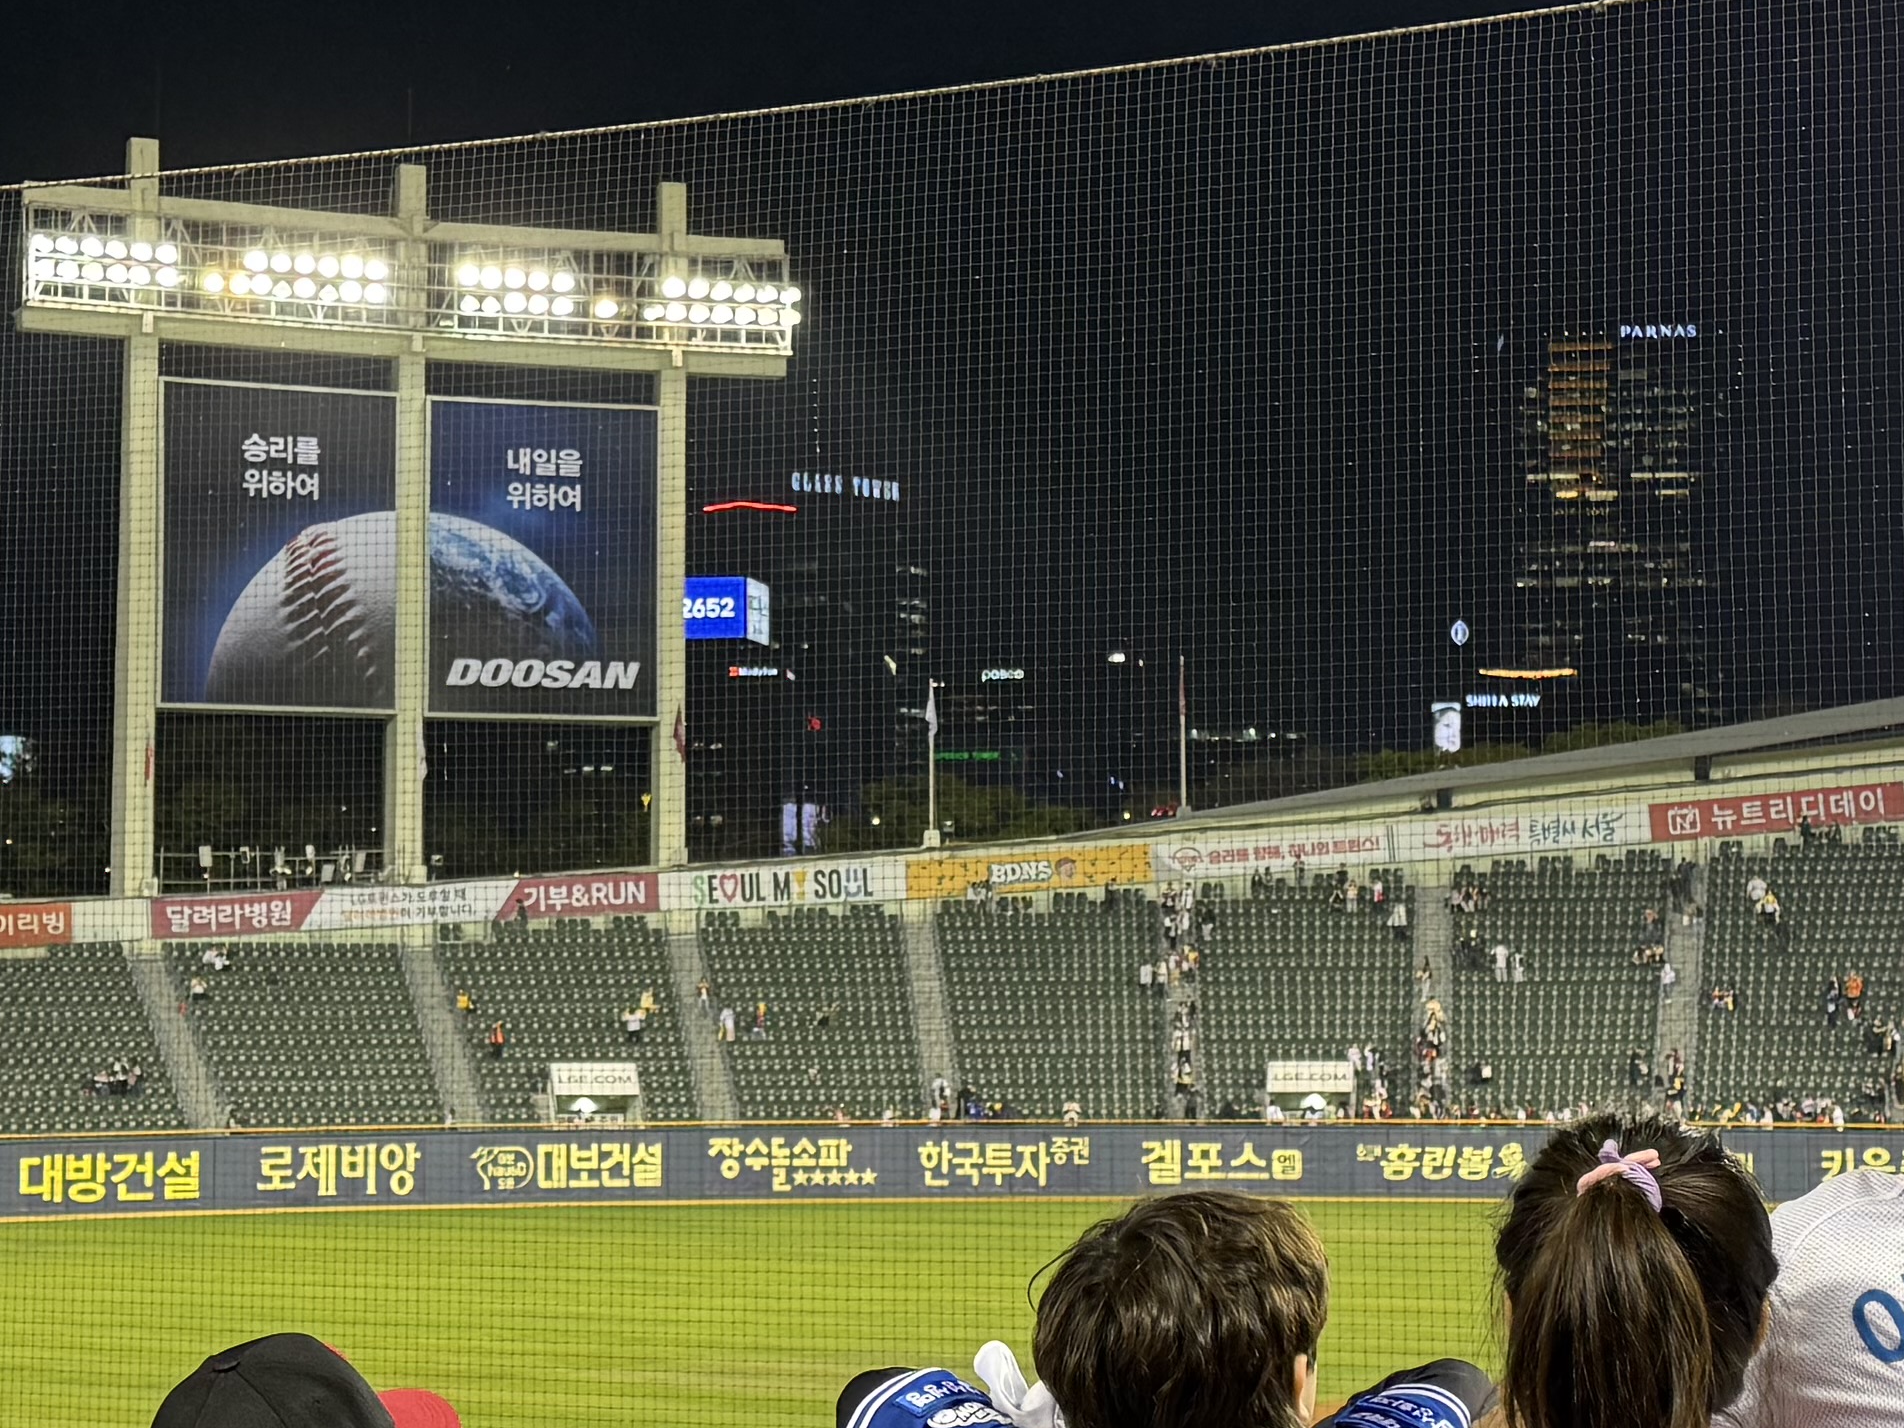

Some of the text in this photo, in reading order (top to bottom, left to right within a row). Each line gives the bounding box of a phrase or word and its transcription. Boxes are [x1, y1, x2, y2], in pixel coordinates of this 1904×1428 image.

[1620, 324, 1697, 338] PARNAS
[241, 433, 322, 466] 승리를
[506, 448, 583, 477] 내일을
[242, 470, 320, 501] 위하여
[506, 482, 582, 512] 위하여
[446, 658, 640, 689] DOOSAN
[1511, 694, 1541, 708] STAY
[1582, 812, 1623, 843] 서울
[813, 866, 874, 900] SOUL
[989, 860, 1052, 885] BDNS
[524, 880, 646, 912] 기부&RUN
[166, 900, 292, 933] 달려라병원
[558, 1073, 635, 1086] LGE.COM
[19, 1150, 201, 1204] 대방건설
[257, 1142, 421, 1197] 로제비앙
[537, 1142, 663, 1189] 대보건설
